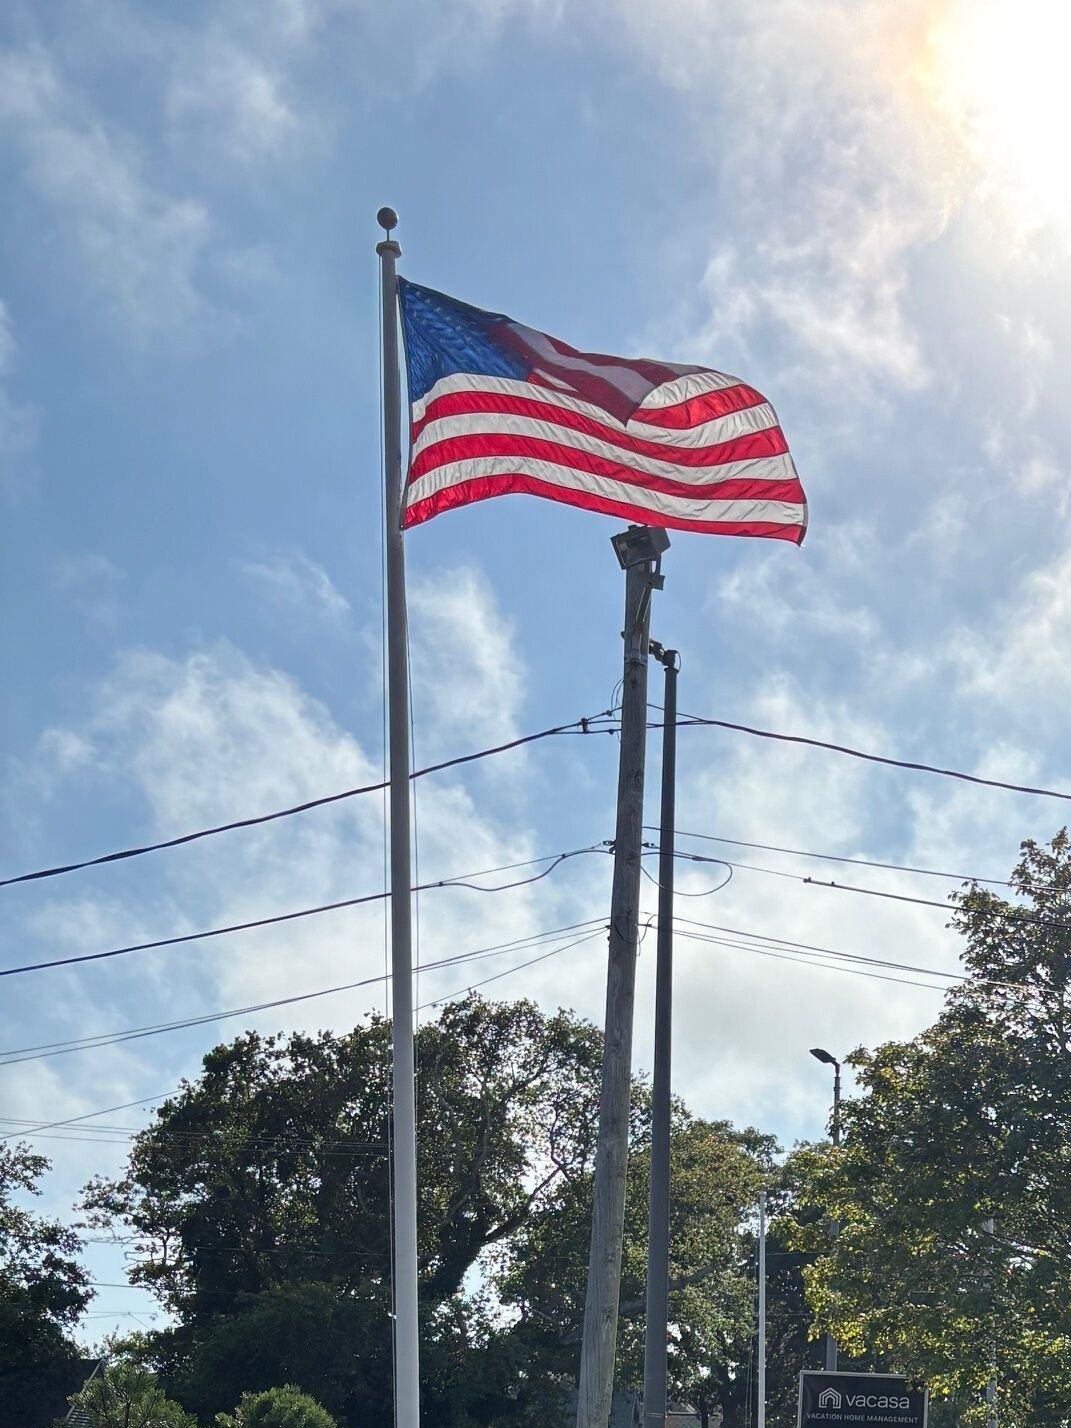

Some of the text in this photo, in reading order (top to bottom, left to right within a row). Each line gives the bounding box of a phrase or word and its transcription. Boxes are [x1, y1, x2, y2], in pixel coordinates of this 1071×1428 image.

[845, 1394, 910, 1409] vacasa
[807, 1412, 842, 1420] VACATION
[867, 1415, 919, 1423] MANAGEMENT
